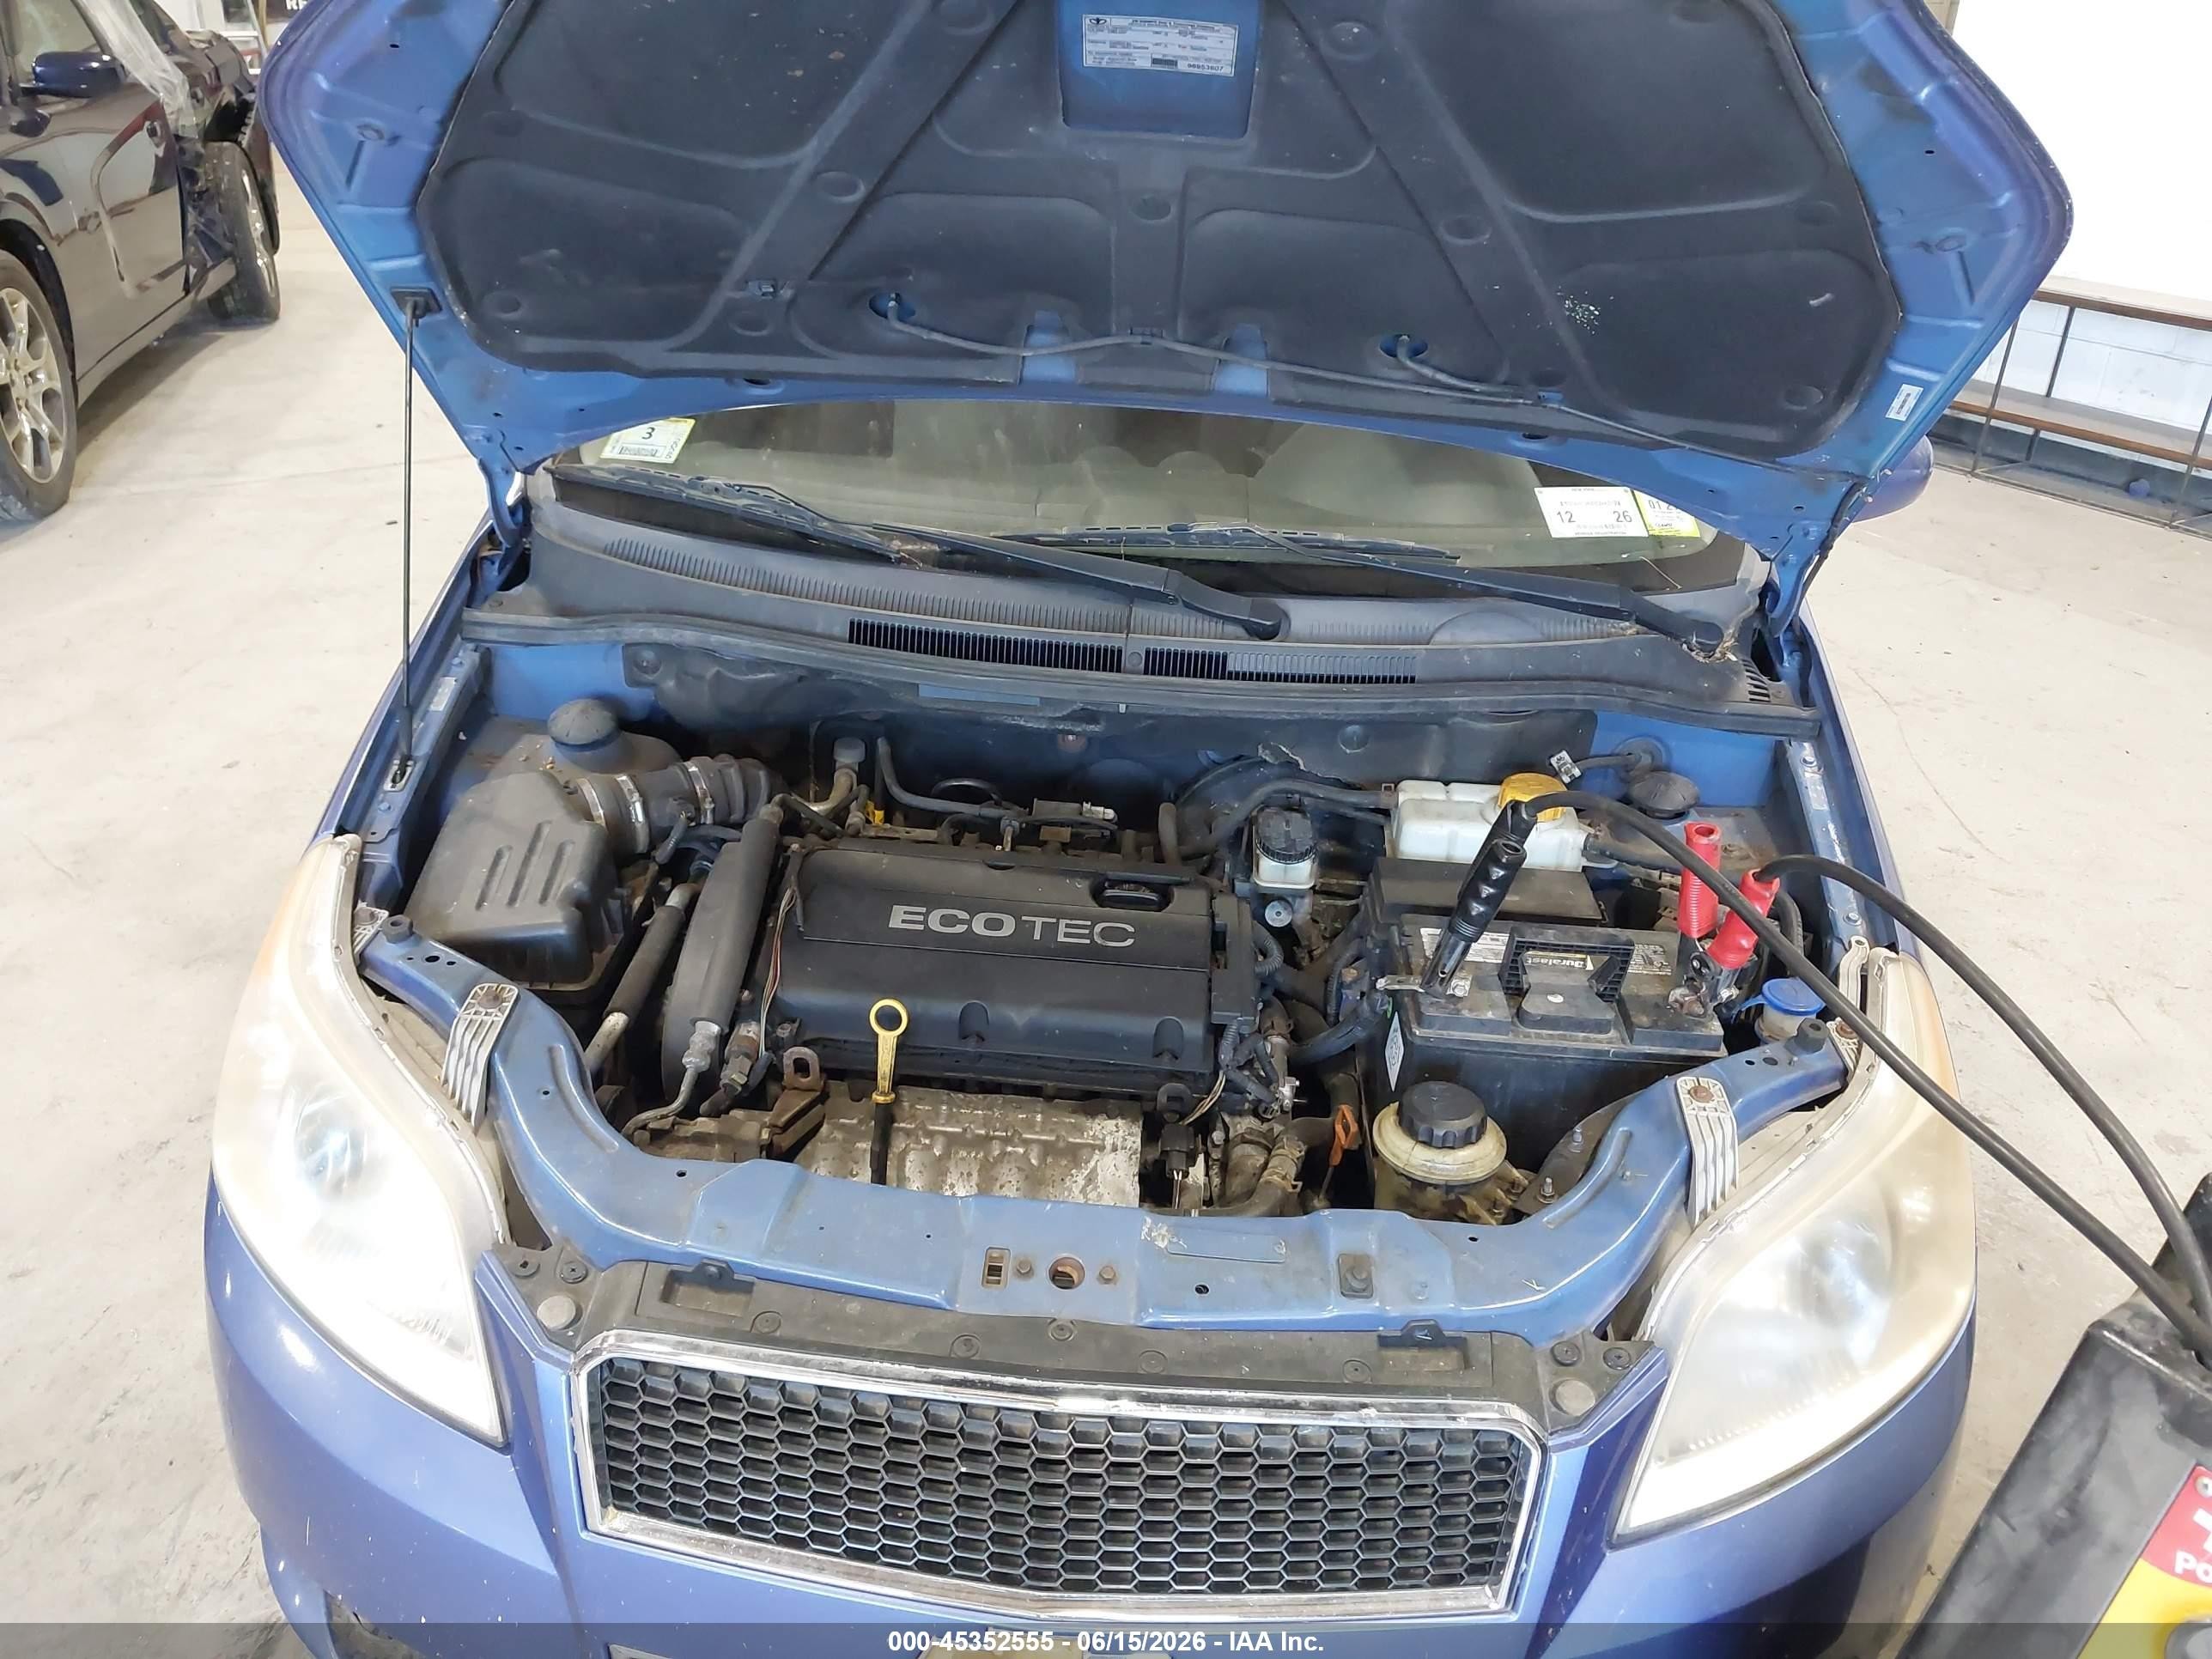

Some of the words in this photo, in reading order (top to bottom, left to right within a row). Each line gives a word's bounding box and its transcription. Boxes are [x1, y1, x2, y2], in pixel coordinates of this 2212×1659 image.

[641, 426, 656, 441] 3
[1556, 510, 1577, 523] 12
[1613, 510, 1632, 523] 26
[888, 904, 1135, 947] ECOTEC
[1526, 957, 1584, 969] Duralast
